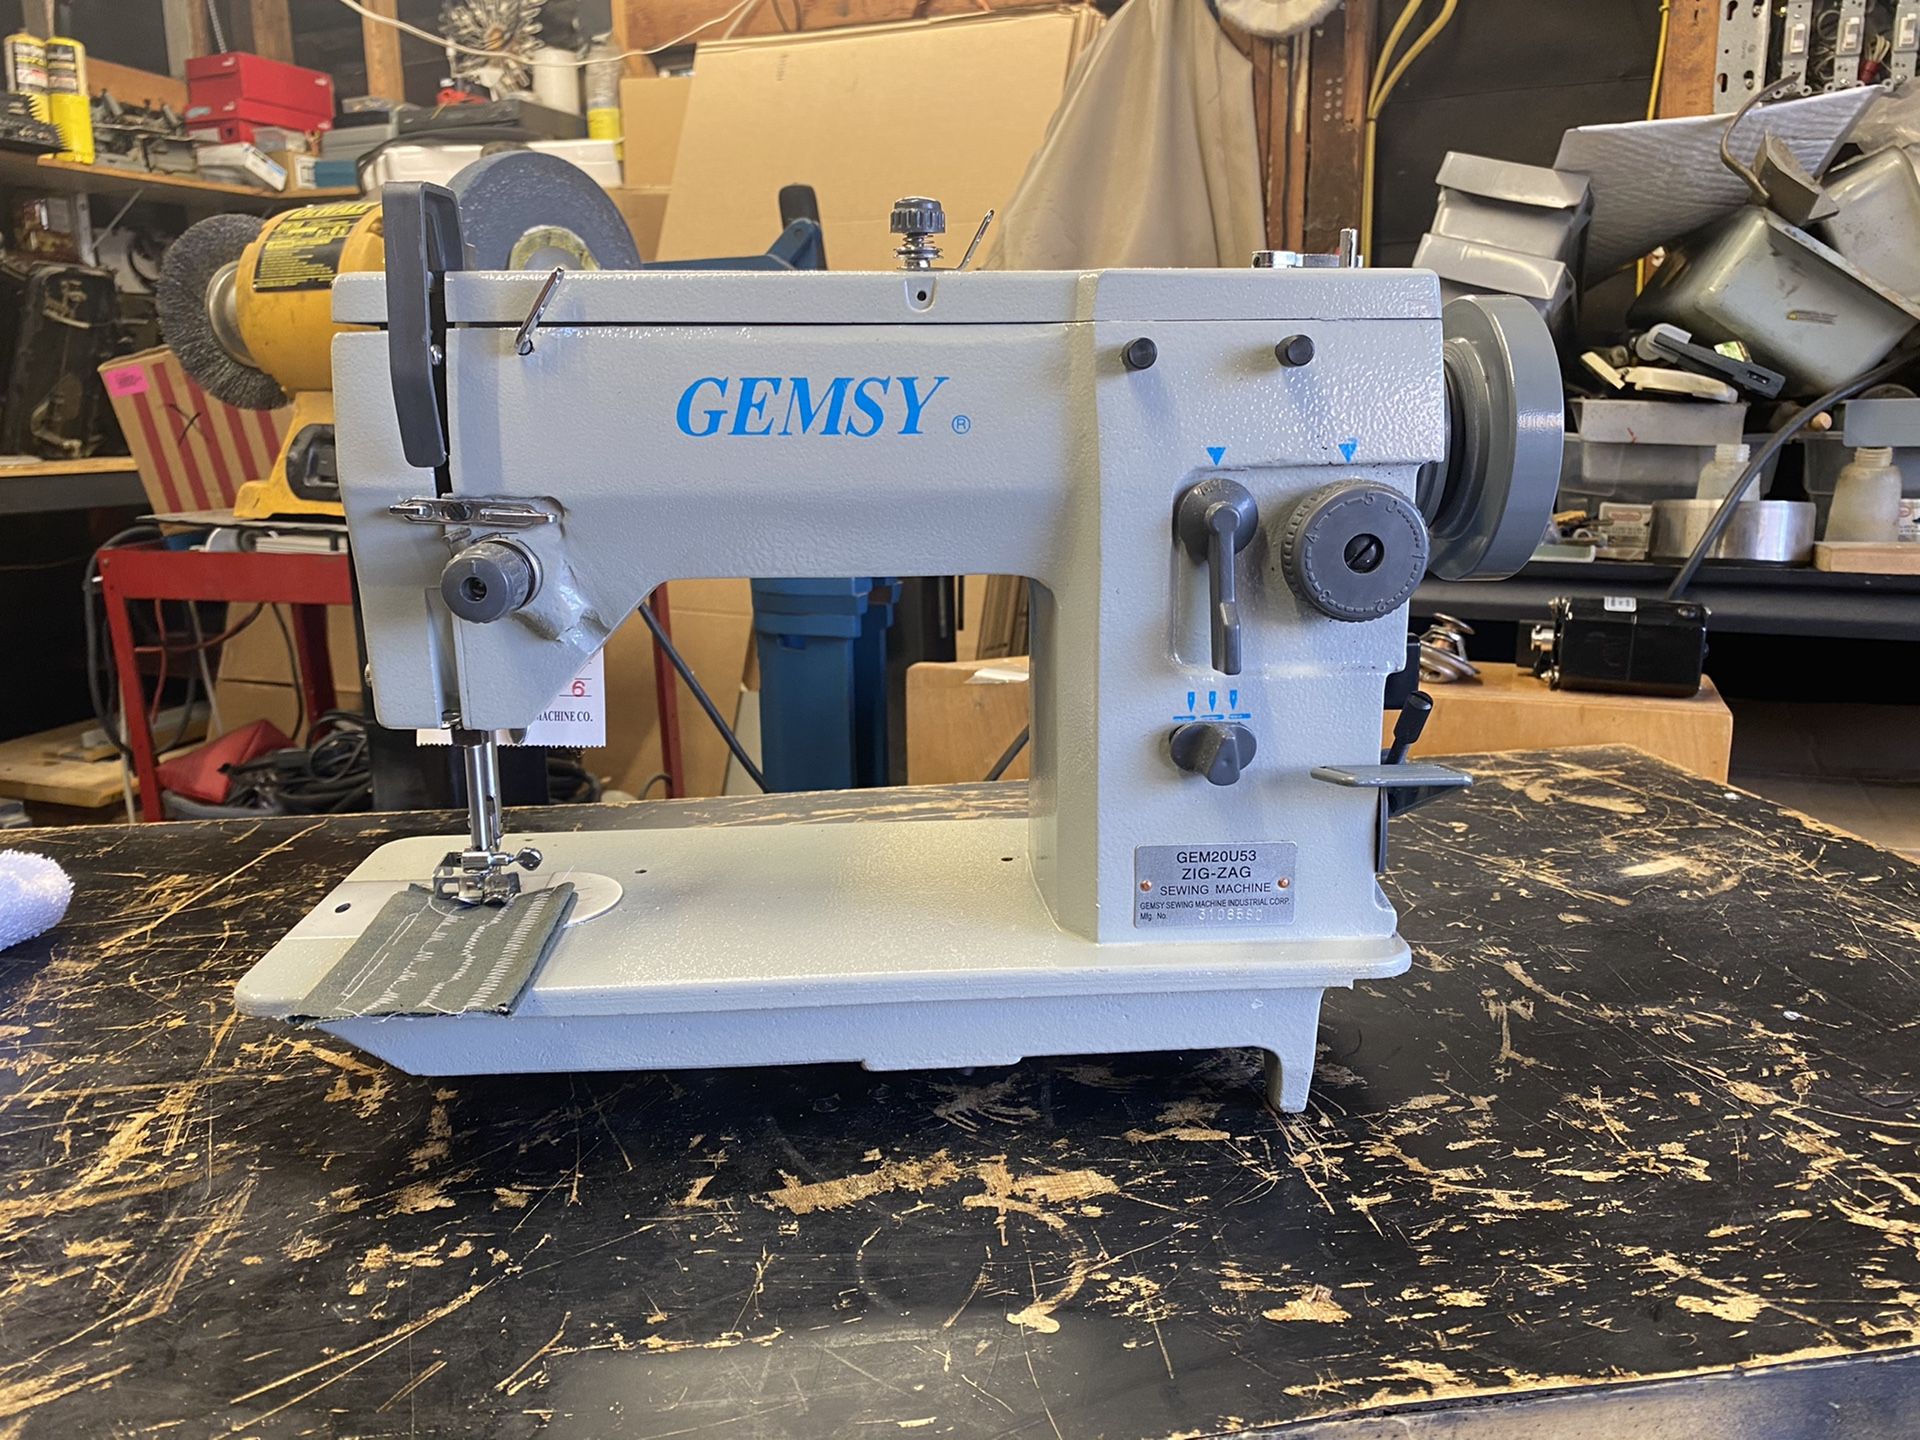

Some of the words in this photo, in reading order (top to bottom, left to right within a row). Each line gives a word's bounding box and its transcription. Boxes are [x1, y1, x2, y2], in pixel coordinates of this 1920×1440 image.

[676, 376, 950, 437] GEMSY
[571, 681, 585, 697] 6
[577, 711, 593, 721] CO.
[1176, 850, 1257, 863] GEM20U53
[1182, 866, 1252, 880] ZIG-ZAG
[1160, 885, 1209, 896] SEWING
[1215, 882, 1271, 894] MACHINE
[1140, 902, 1166, 910] GEMSY
[1166, 900, 1194, 909] SEWING
[1195, 899, 1227, 908] MACHINE
[1227, 898, 1268, 907] INDUSTRIAL
[1269, 897, 1291, 906] CORP.
